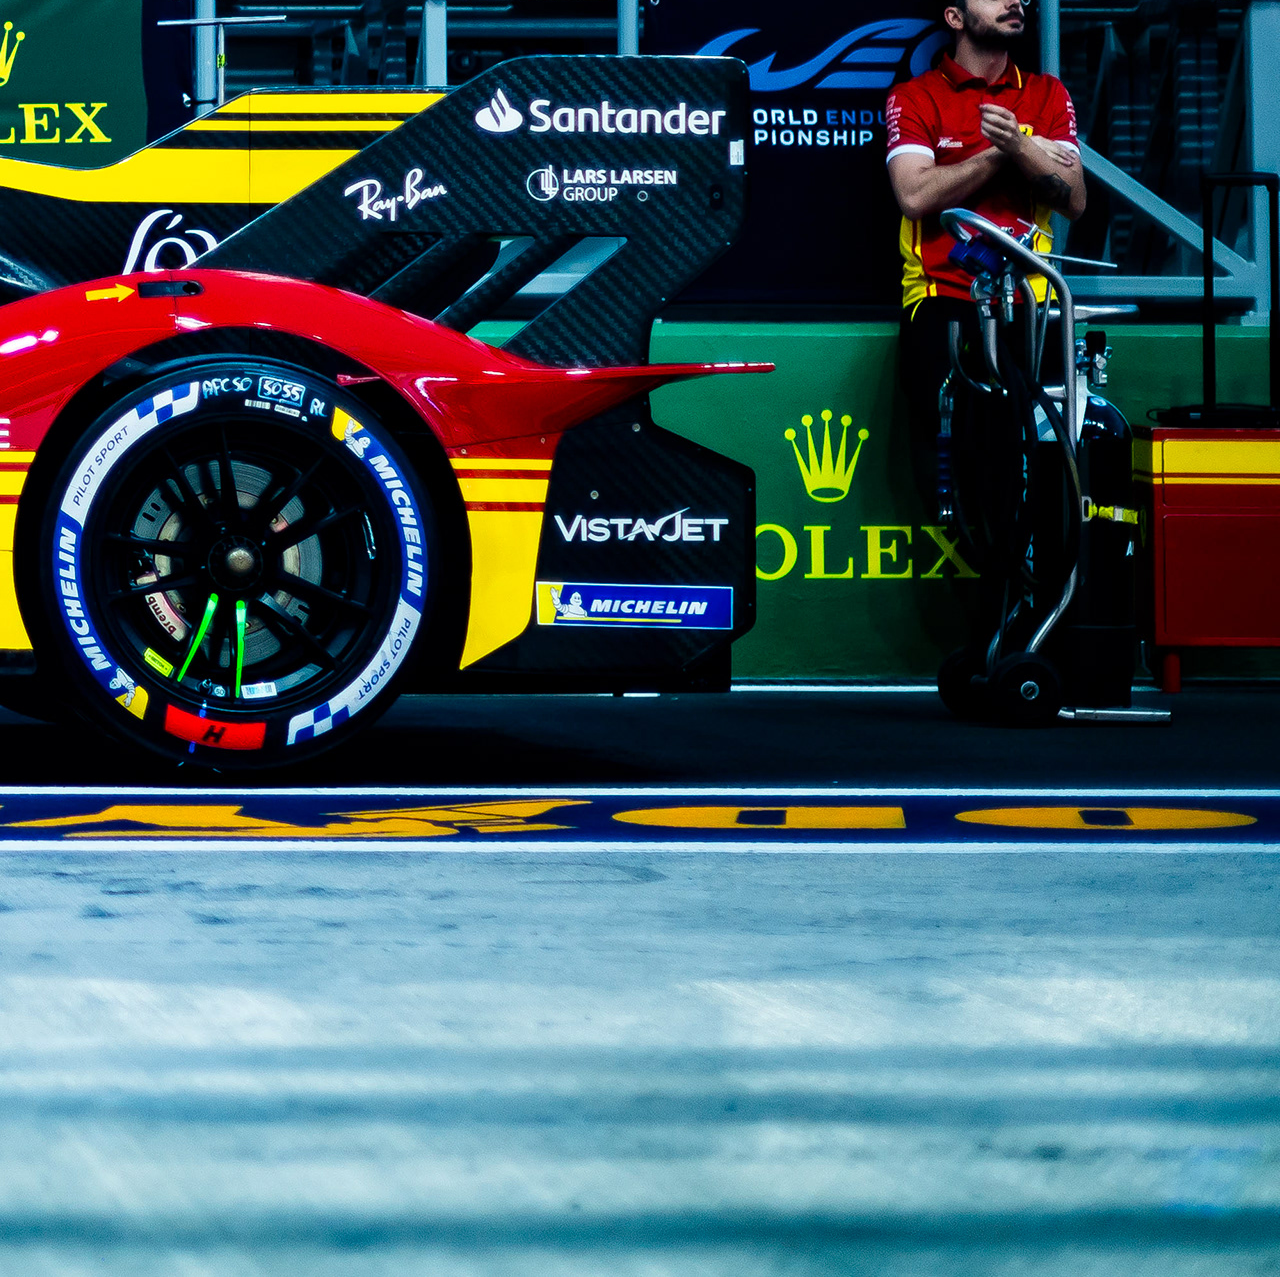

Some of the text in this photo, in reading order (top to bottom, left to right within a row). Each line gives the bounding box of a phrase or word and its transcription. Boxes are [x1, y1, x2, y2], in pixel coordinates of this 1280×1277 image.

[528, 99, 727, 136] Santander
[754, 129, 873, 146] PIONSHIP
[344, 168, 447, 222] Ray-Ban
[562, 169, 676, 186] LARS LARSEN
[562, 187, 618, 202] GROUP
[73, 425, 130, 507] PILOT SPORT
[369, 455, 423, 596] MICHELIN
[59, 527, 111, 671] MICHELIN
[590, 598, 708, 616] MICHELIN
[358, 619, 412, 701] PILOT SPORT
[202, 725, 226, 743] H
